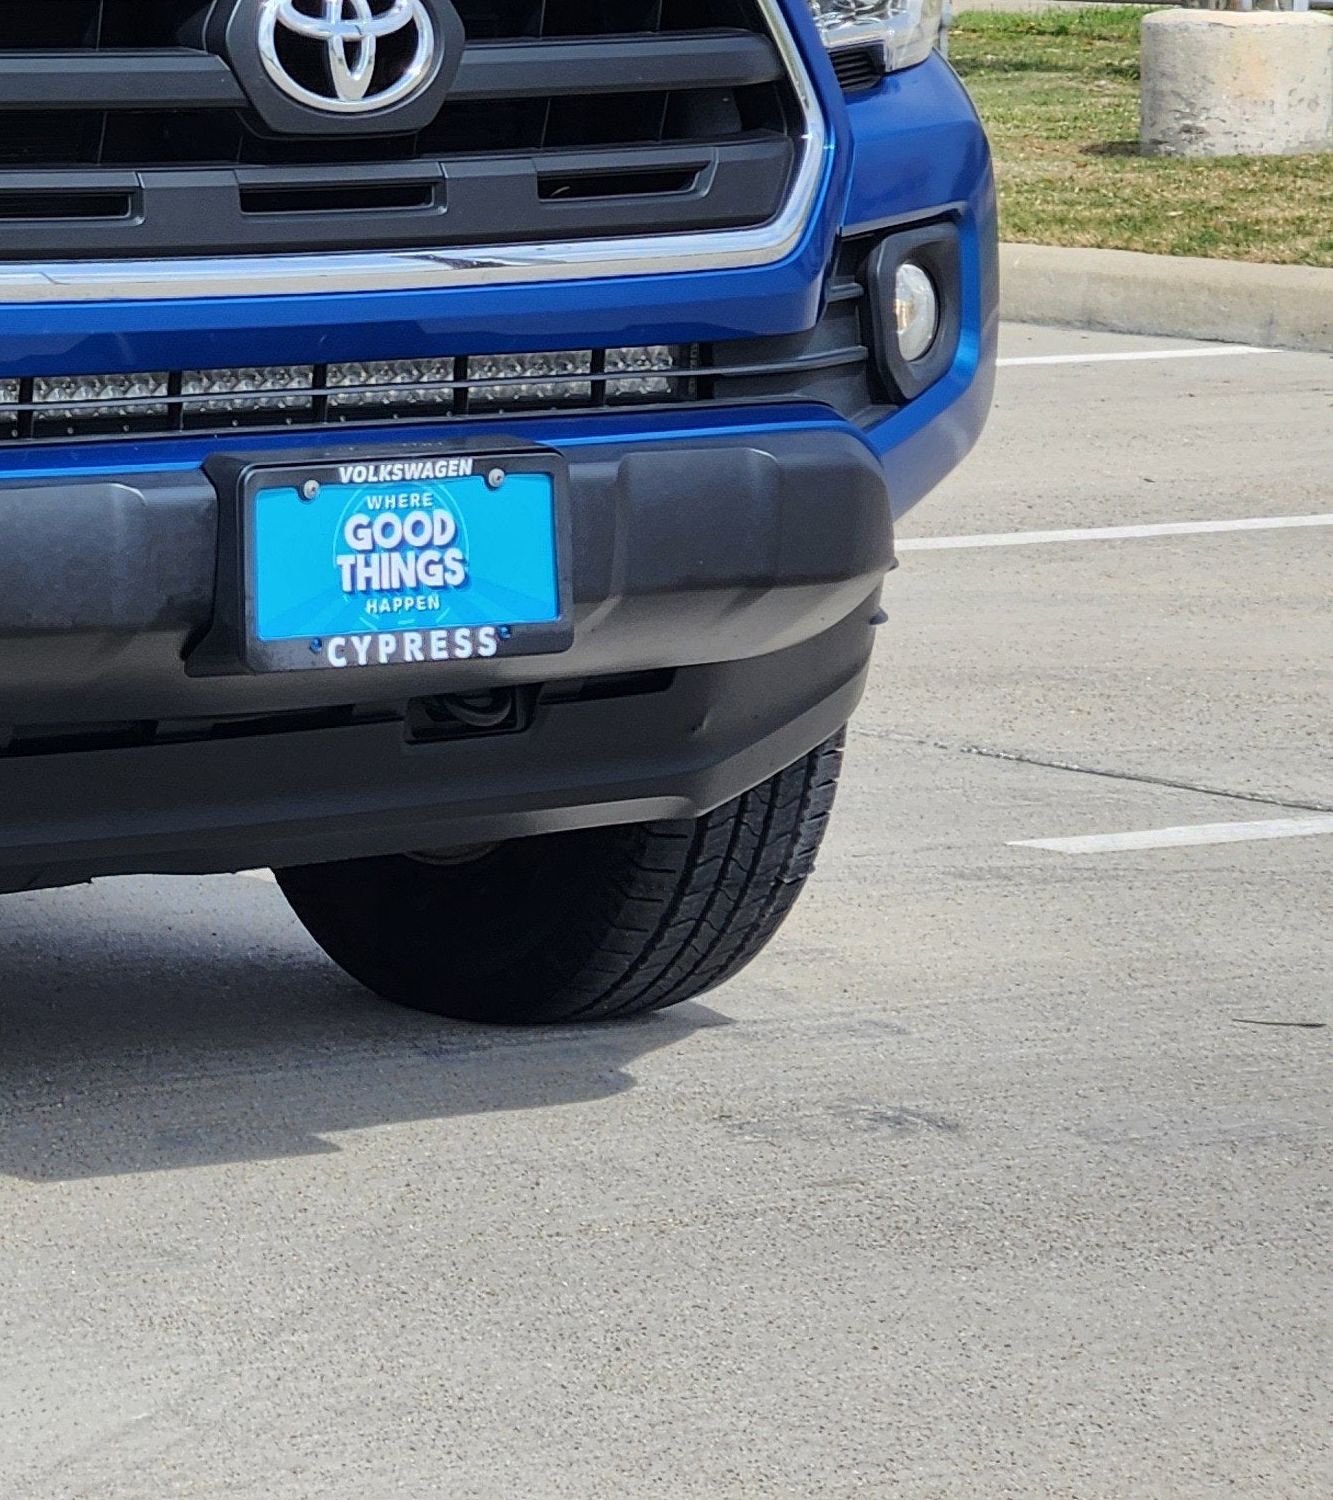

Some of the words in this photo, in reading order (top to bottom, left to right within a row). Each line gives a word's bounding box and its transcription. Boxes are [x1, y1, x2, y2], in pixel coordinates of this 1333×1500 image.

[339, 458, 473, 484] VOLKSWAGEN
[367, 492, 434, 509] WHERE
[344, 508, 457, 551] GOOD
[336, 547, 467, 593] THINGS
[366, 596, 440, 614] HAPPEN
[327, 626, 498, 668] CYPRESS
